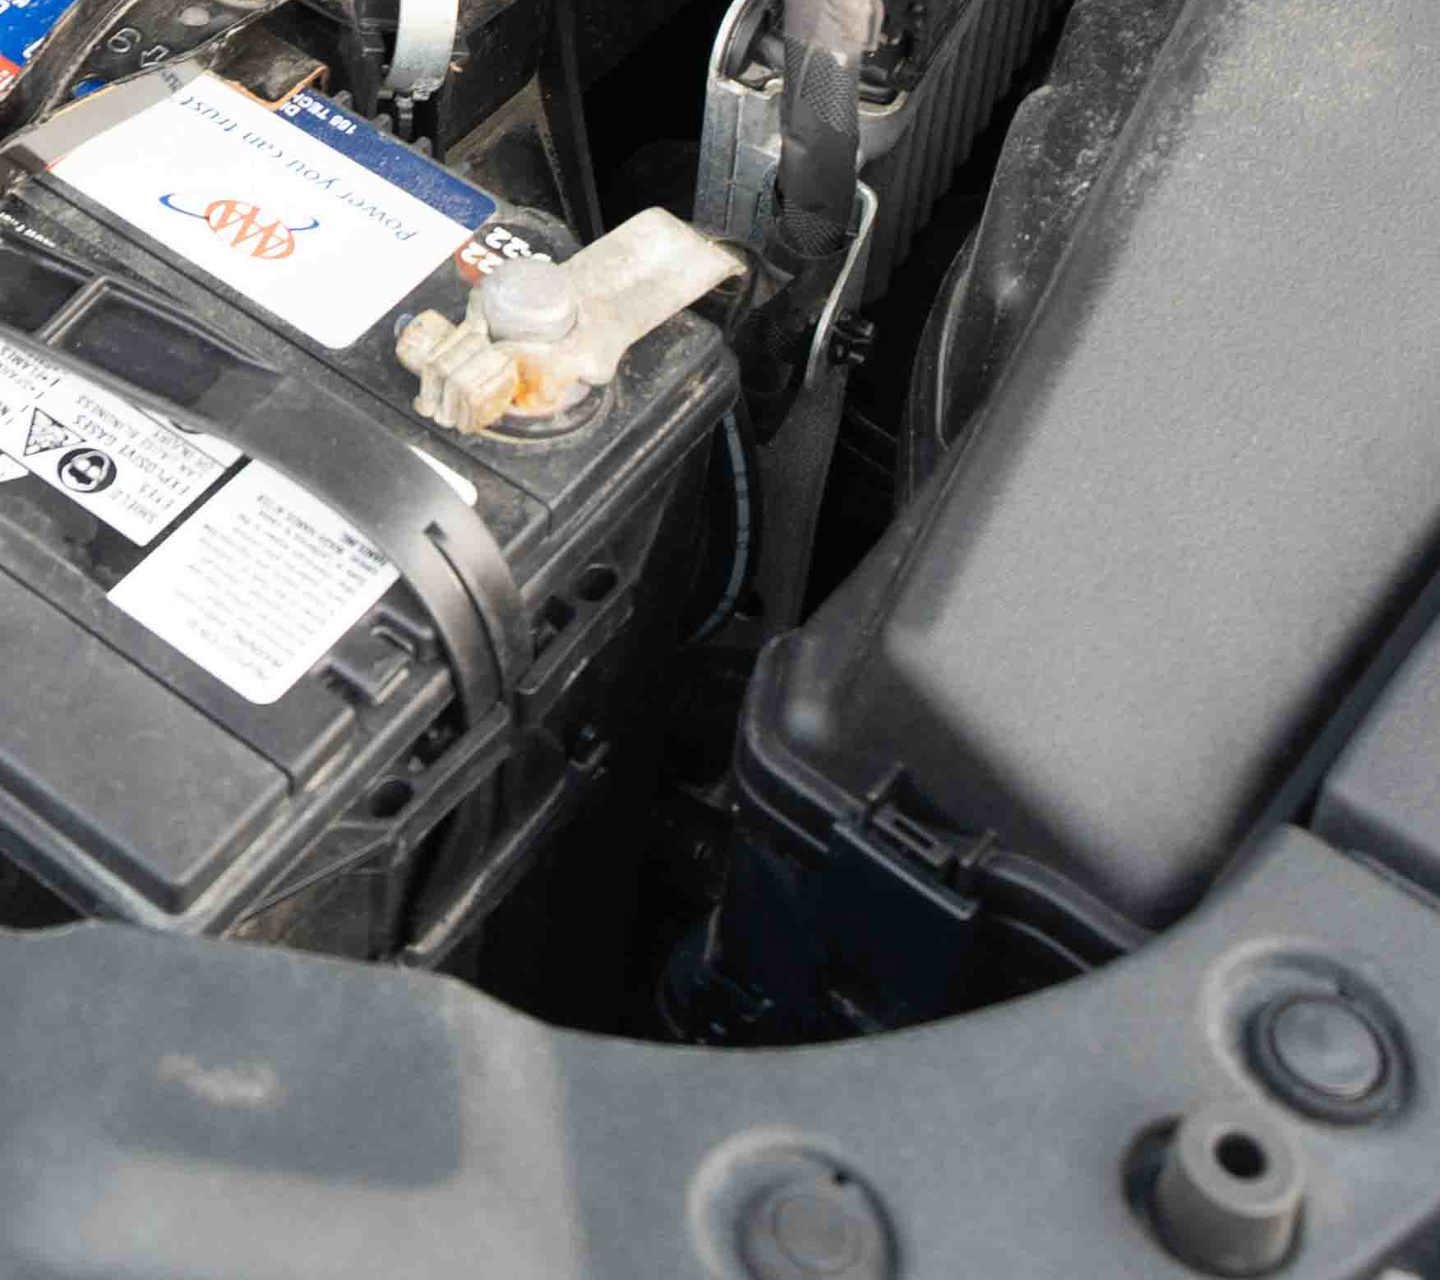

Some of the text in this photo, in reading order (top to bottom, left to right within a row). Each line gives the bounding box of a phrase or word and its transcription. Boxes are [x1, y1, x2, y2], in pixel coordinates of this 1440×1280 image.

[289, 90, 330, 121] TECH
[180, 95, 419, 242] Power you can trust
[206, 199, 296, 260] AAA
